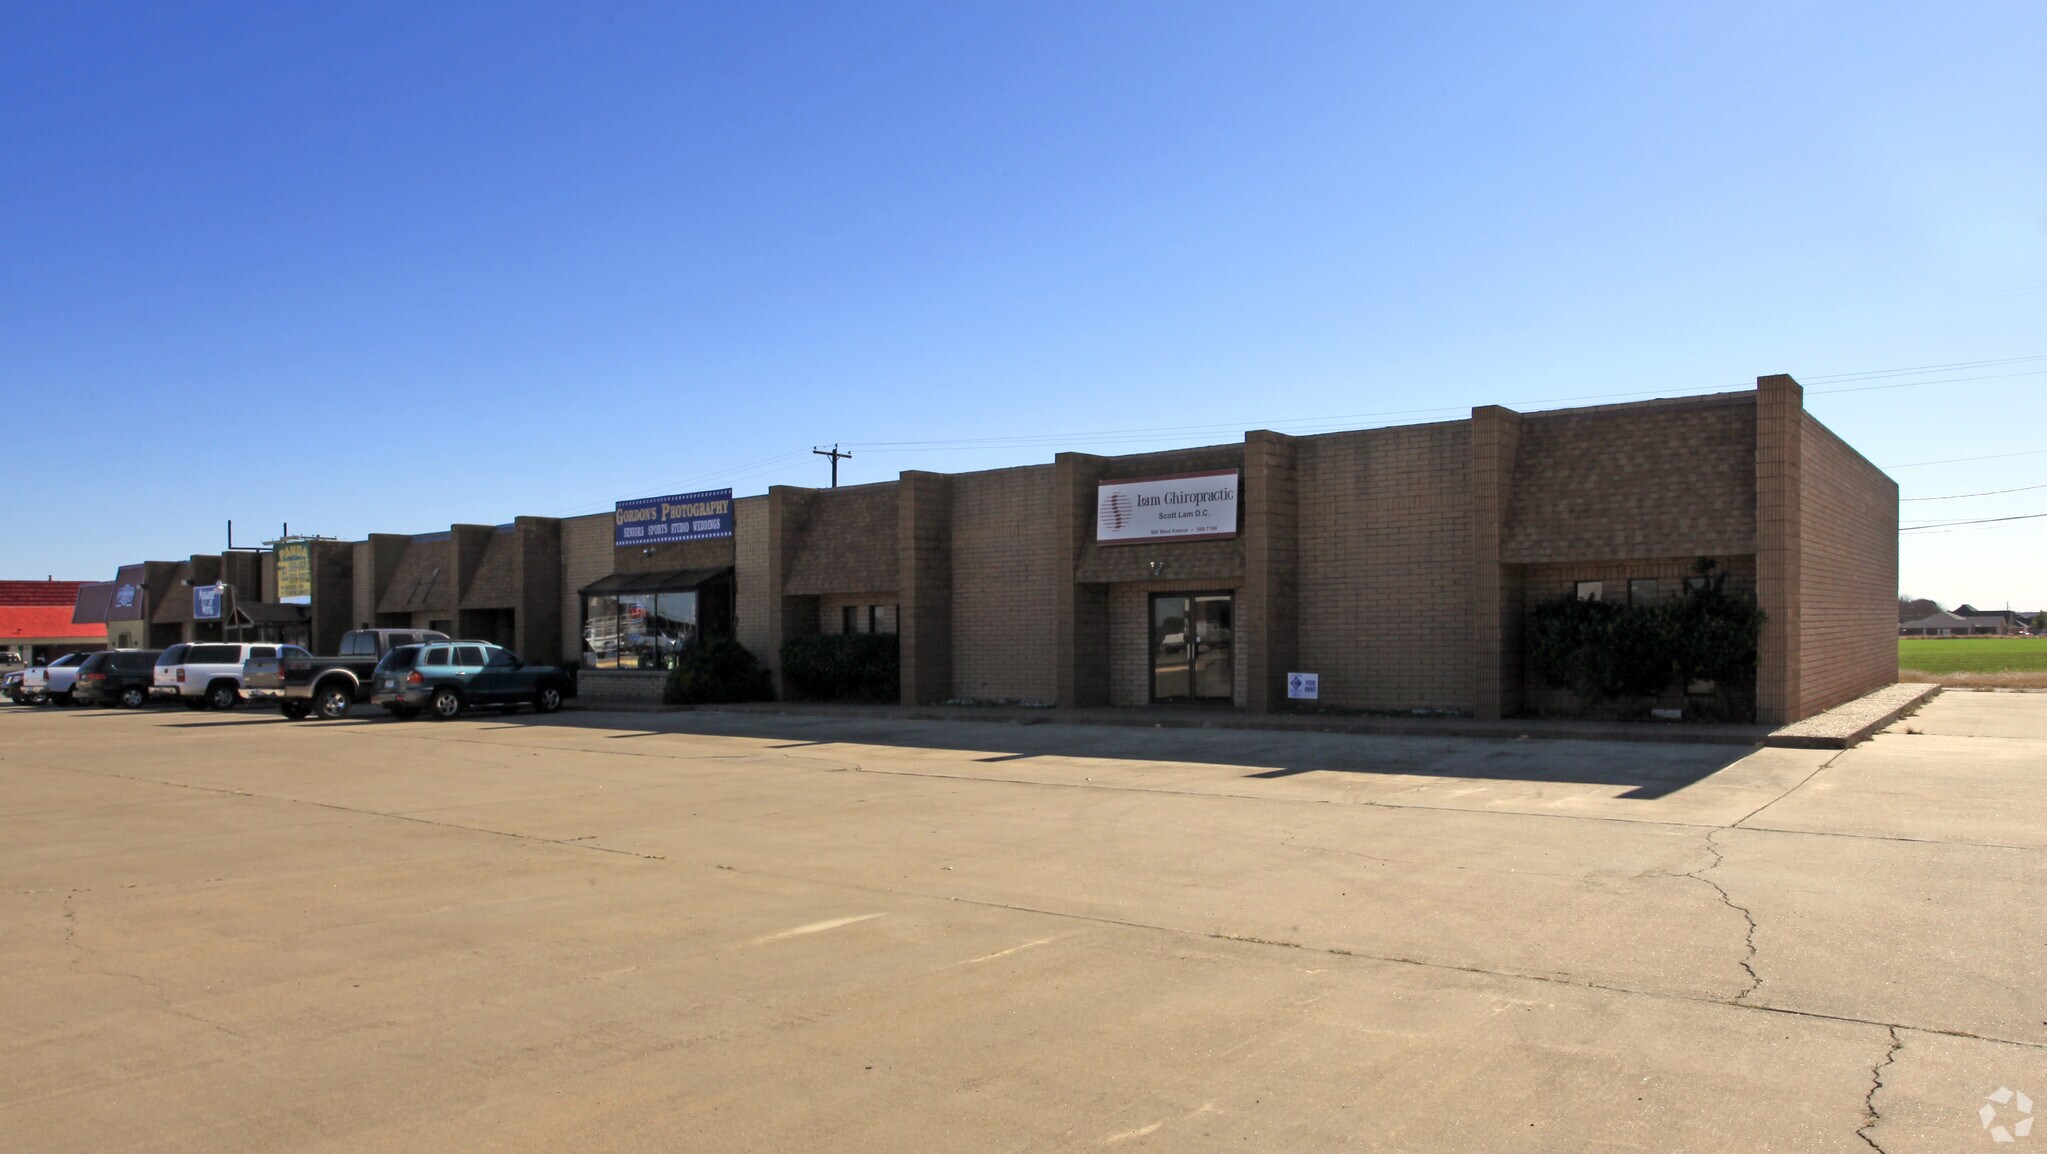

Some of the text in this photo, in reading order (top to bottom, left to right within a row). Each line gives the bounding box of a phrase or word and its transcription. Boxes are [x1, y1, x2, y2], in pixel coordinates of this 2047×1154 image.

[1164, 488, 1234, 506] Chiropractic
[615, 500, 729, 525] GORDON'S PHOTOGRAPHY
[1158, 512, 1177, 520] Scott
[1195, 509, 1210, 517] D.C.
[623, 518, 721, 538] SENIORS SPORTS STUDIO WEDDINGS
